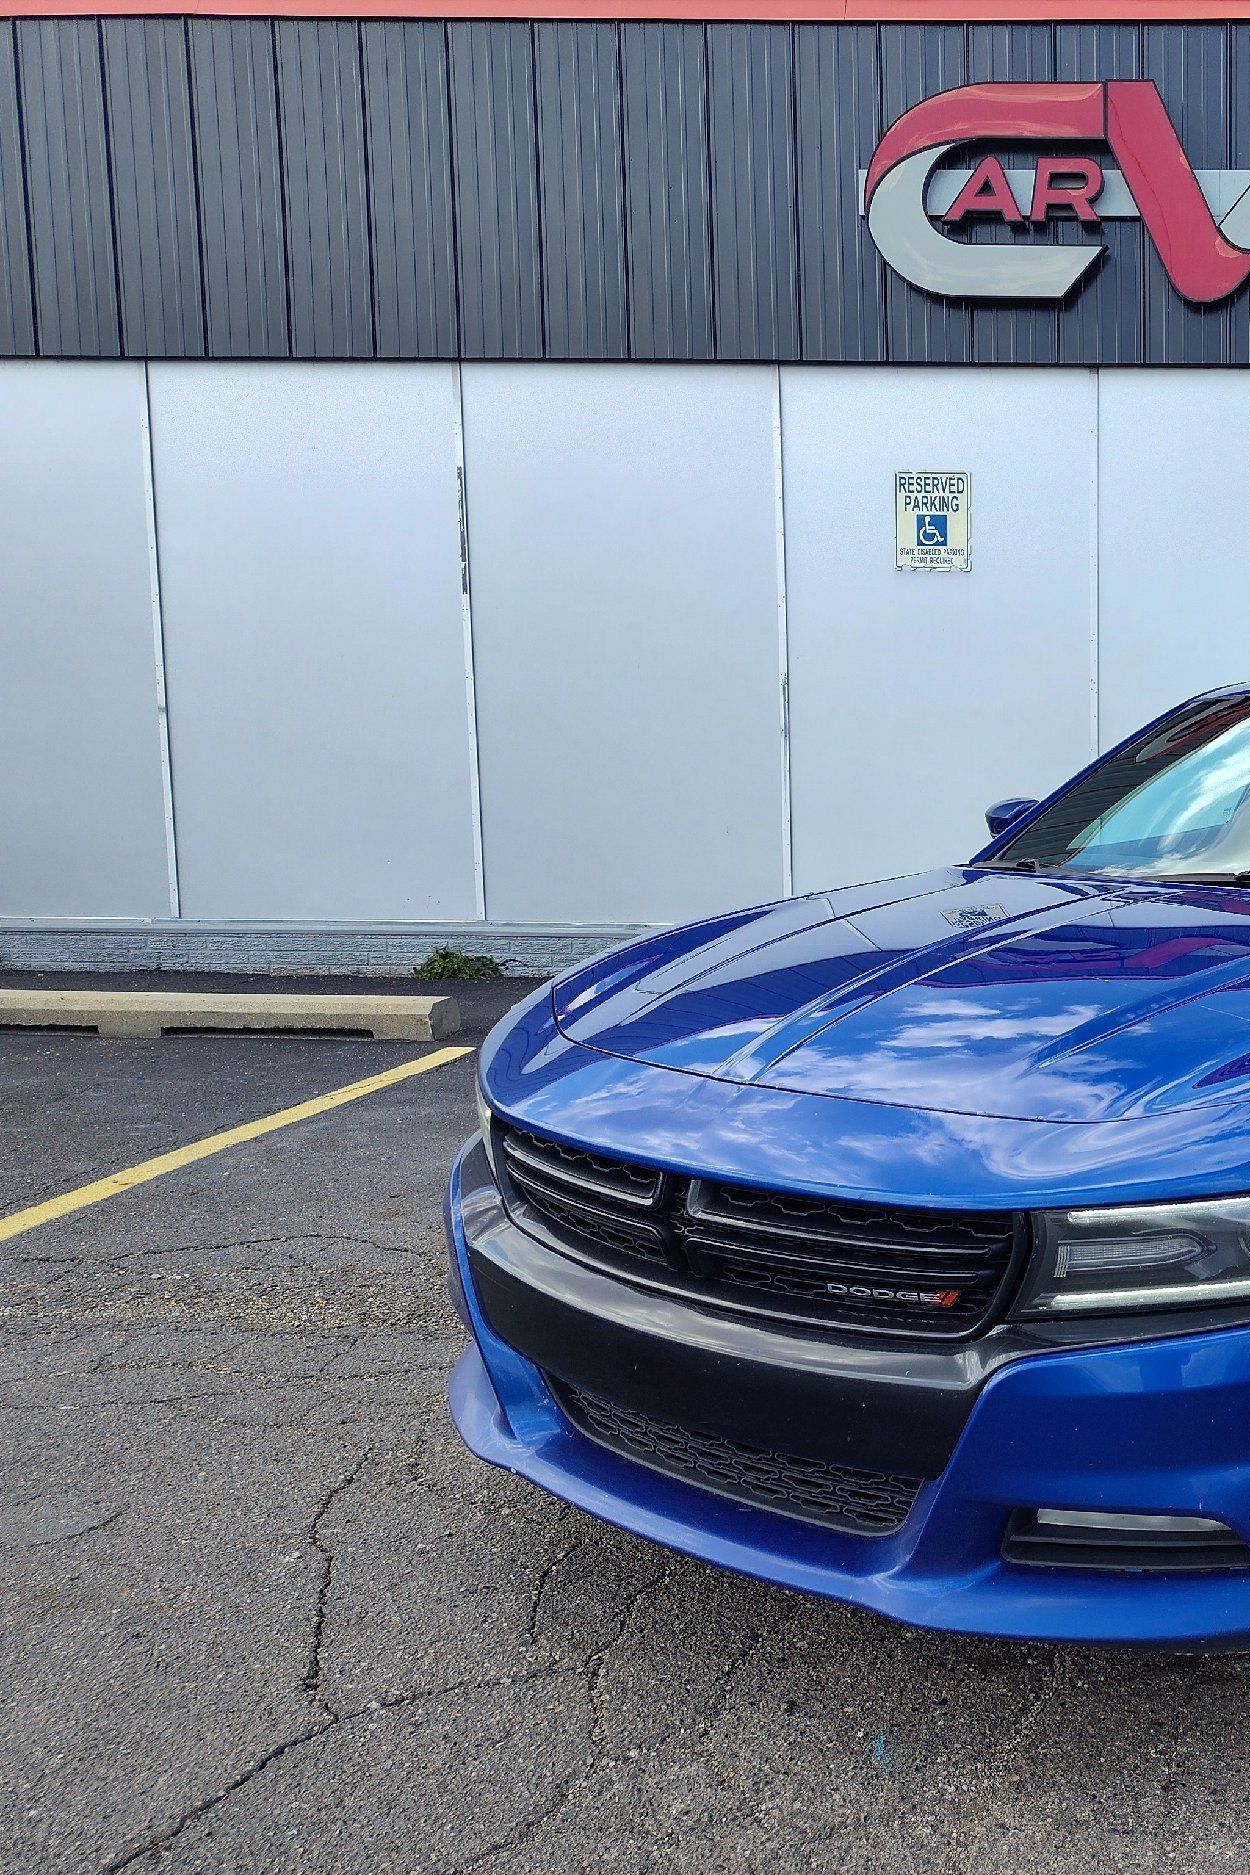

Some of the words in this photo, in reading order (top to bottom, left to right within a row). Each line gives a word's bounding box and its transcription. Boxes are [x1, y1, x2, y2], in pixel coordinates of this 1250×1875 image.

[899, 476, 965, 494] RESERVED
[904, 496, 960, 512] PARKING
[900, 548, 915, 556] STATE
[827, 1283, 941, 1303] DODGE
